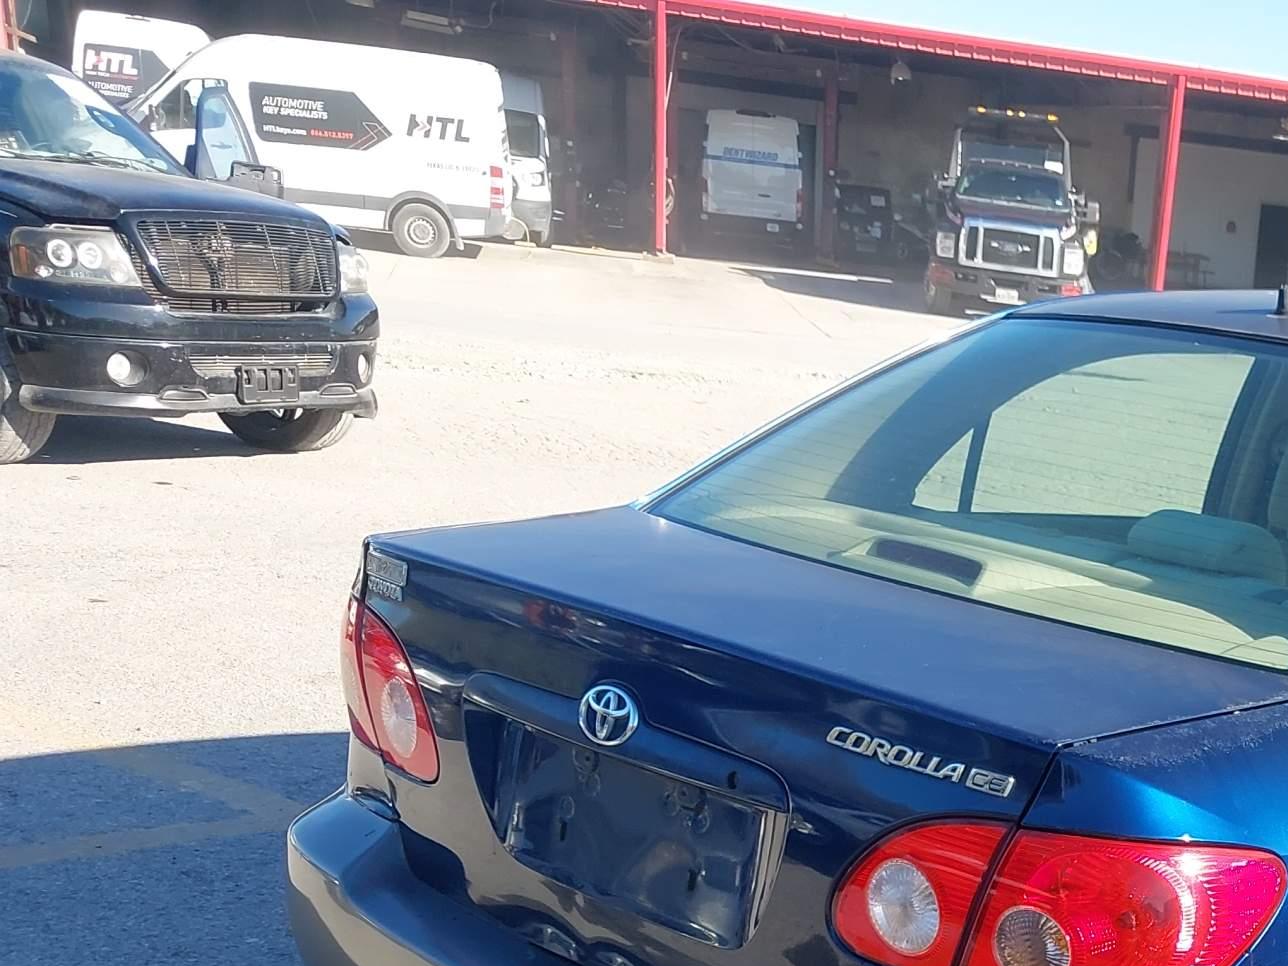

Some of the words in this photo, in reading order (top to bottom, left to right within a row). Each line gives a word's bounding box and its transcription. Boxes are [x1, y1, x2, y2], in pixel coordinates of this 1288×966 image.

[84, 48, 138, 76] HTL
[262, 95, 325, 111] AUTOMOTIVE
[262, 105, 280, 115] KEY
[280, 107, 328, 120] SPECIALISTS
[406, 113, 471, 143] HTL
[825, 726, 966, 784] COROLLA
[969, 770, 1012, 796] CE
